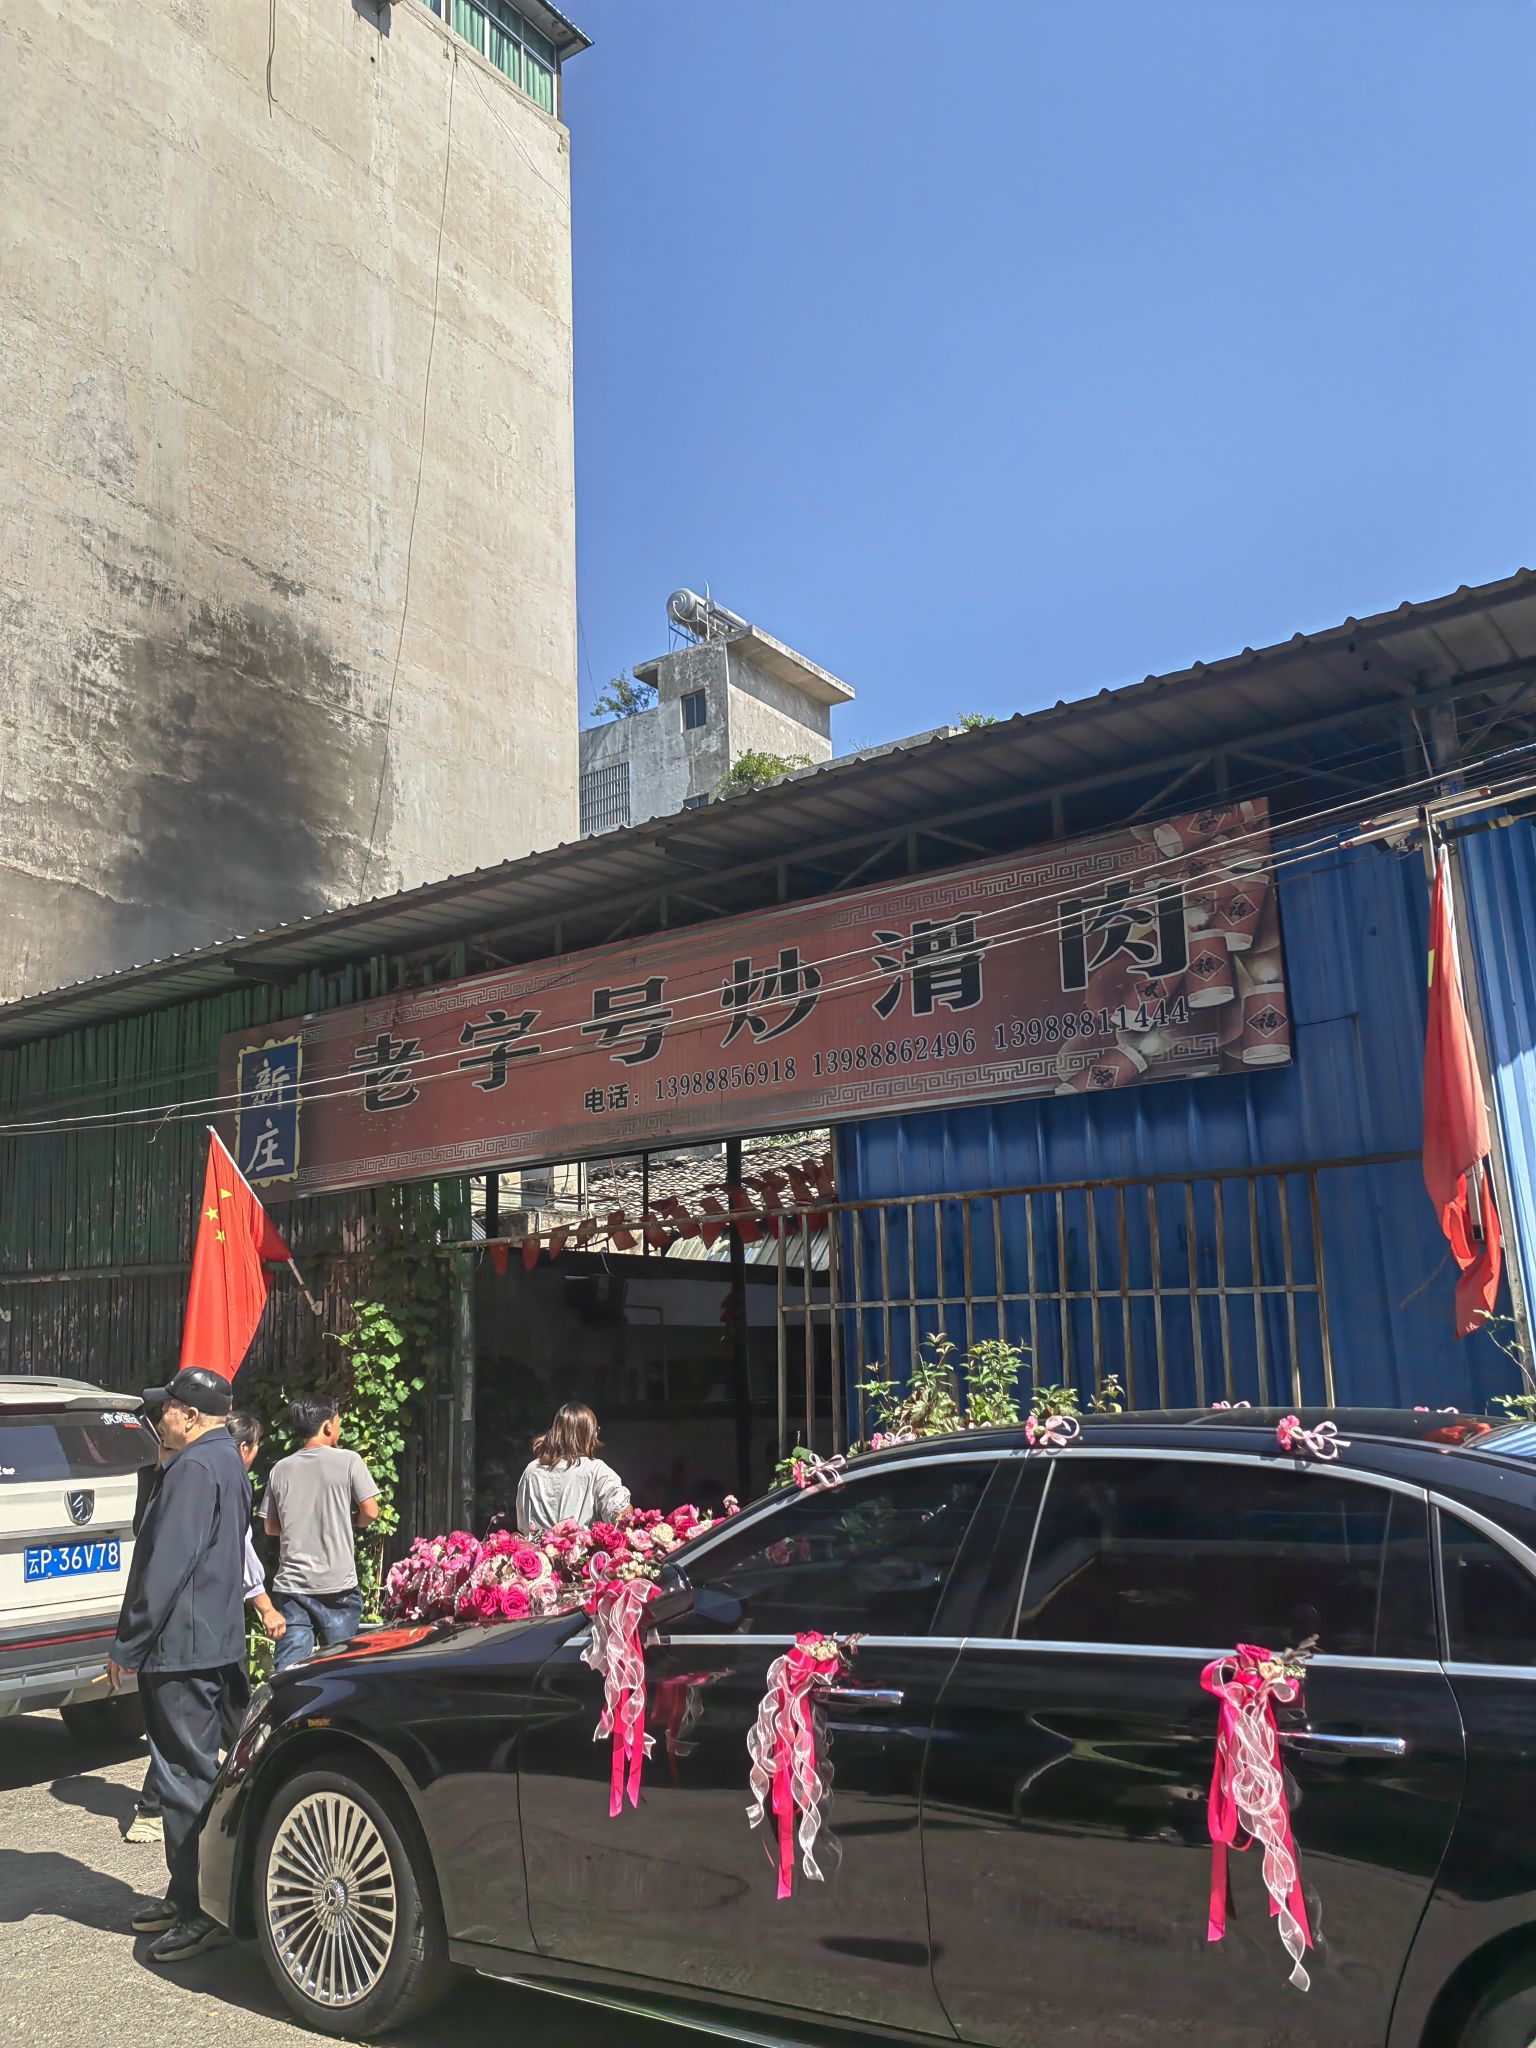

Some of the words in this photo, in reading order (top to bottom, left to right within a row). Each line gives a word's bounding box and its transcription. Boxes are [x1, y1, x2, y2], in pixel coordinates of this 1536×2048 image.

[348, 878, 1189, 1113] 老字号炒滑肉
[655, 1056, 796, 1101] 13988856918
[812, 1027, 976, 1077] 13988862496
[995, 995, 1189, 1050] 13988811444
[243, 1056, 291, 1175] 新庄
